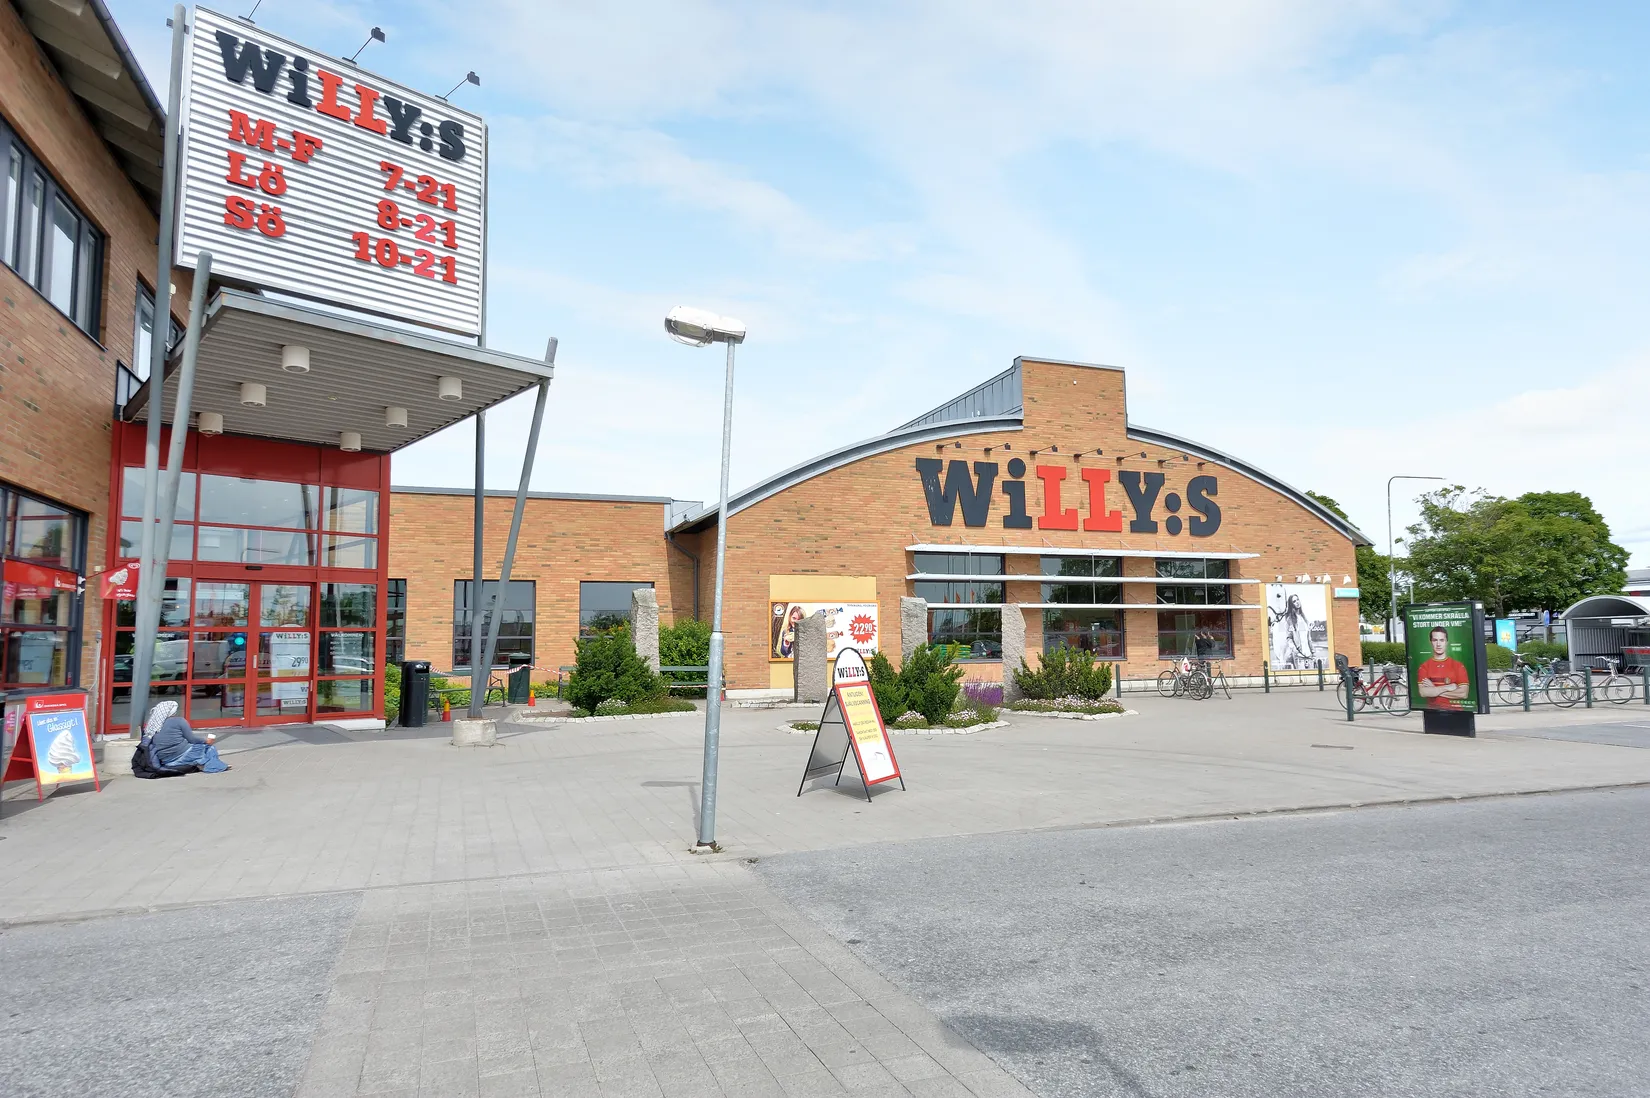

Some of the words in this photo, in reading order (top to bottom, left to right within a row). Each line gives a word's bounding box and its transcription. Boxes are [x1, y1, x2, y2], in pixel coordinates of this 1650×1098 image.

[215, 29, 466, 161] WiLLY:S
[226, 151, 287, 195] Lö
[377, 199, 458, 249] 8-21
[228, 109, 322, 164] M-F
[380, 160, 458, 212] 7-21
[223, 195, 286, 237] Sö
[352, 231, 458, 285] 10-21
[915, 457, 1222, 537] WiLLY:S
